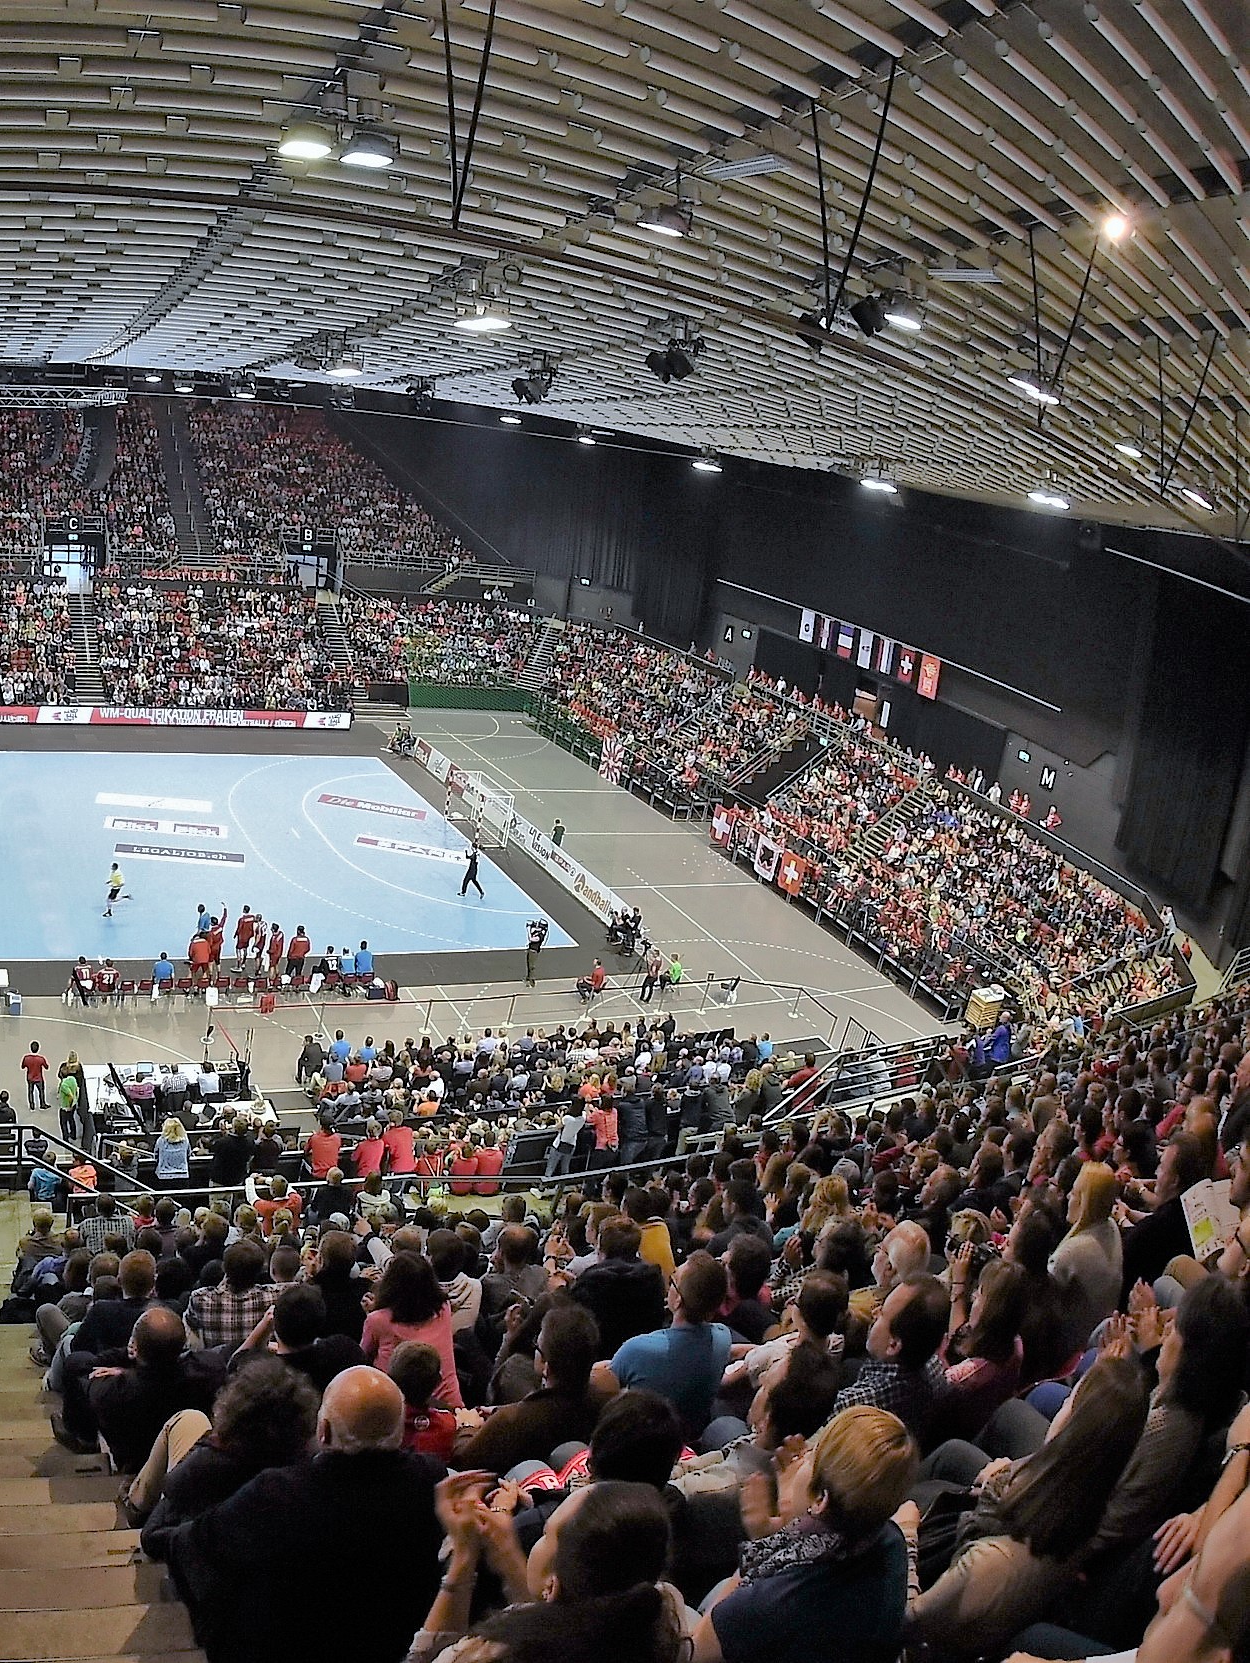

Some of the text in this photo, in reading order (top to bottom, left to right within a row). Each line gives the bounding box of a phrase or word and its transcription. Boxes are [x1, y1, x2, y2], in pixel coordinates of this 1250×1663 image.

[70, 517, 78, 530] C
[304, 529, 313, 541] B
[724, 627, 732, 642] A
[204, 710, 244, 722] FRAUEN
[1041, 767, 1056, 789] M
